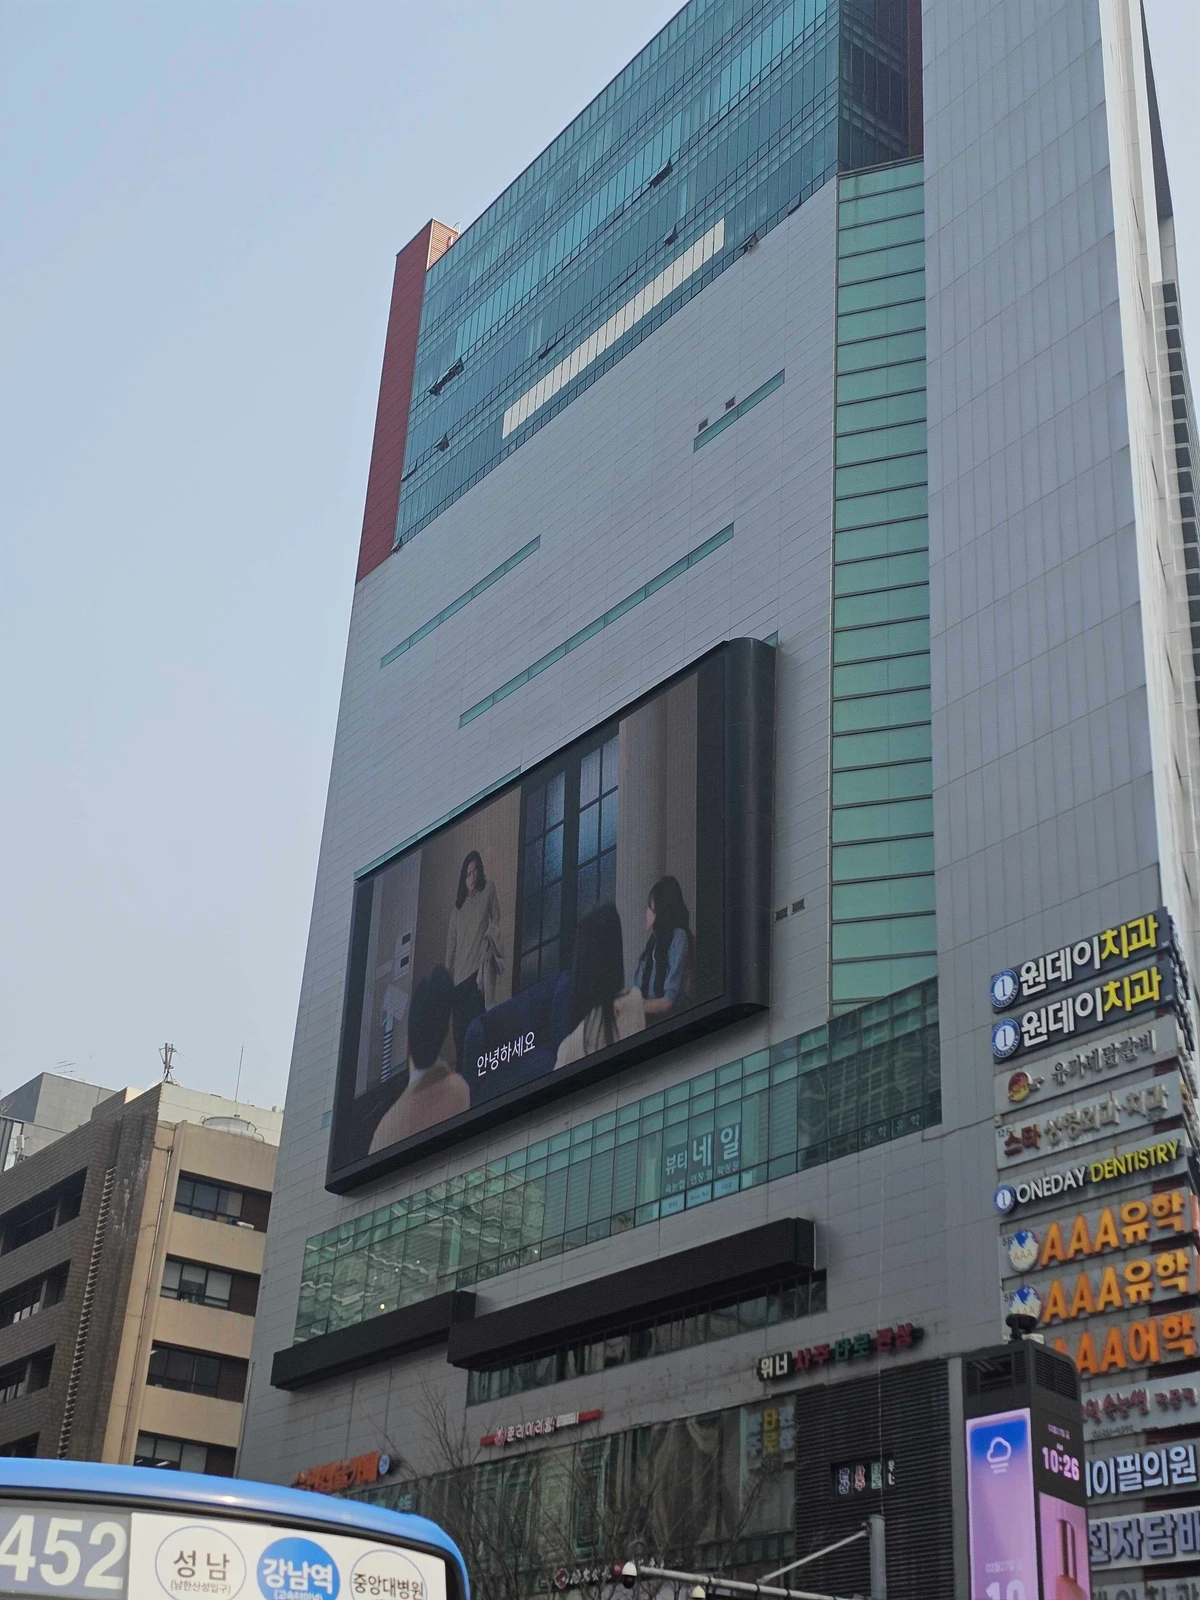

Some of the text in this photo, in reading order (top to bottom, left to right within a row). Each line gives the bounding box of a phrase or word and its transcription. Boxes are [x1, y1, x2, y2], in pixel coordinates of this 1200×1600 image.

[1019, 914, 1159, 997] 원데이치과
[1021, 966, 1162, 1048] 원데이치과
[477, 1031, 536, 1077] 안녕하세요
[1051, 1030, 1156, 1085] 유가네닭갈비
[665, 1124, 739, 1176] 뷰티 네일
[1016, 1166, 1086, 1203] ONEDAY
[1090, 1139, 1180, 1184] DENTISTRY
[1040, 1189, 1185, 1267] AAA유학
[1042, 1248, 1189, 1324] AAA유학
[760, 1353, 789, 1379] 위너
[1042, 1446, 1080, 1481] 10:26
[1085, 1445, 1198, 1497] 이필의원
[0, 1514, 127, 1590] 452
[173, 1549, 230, 1579] 성남
[262, 1557, 333, 1594] 강남역
[170, 1578, 231, 1597] (남한산성입구)
[353, 1573, 424, 1600] 중앙대병원
